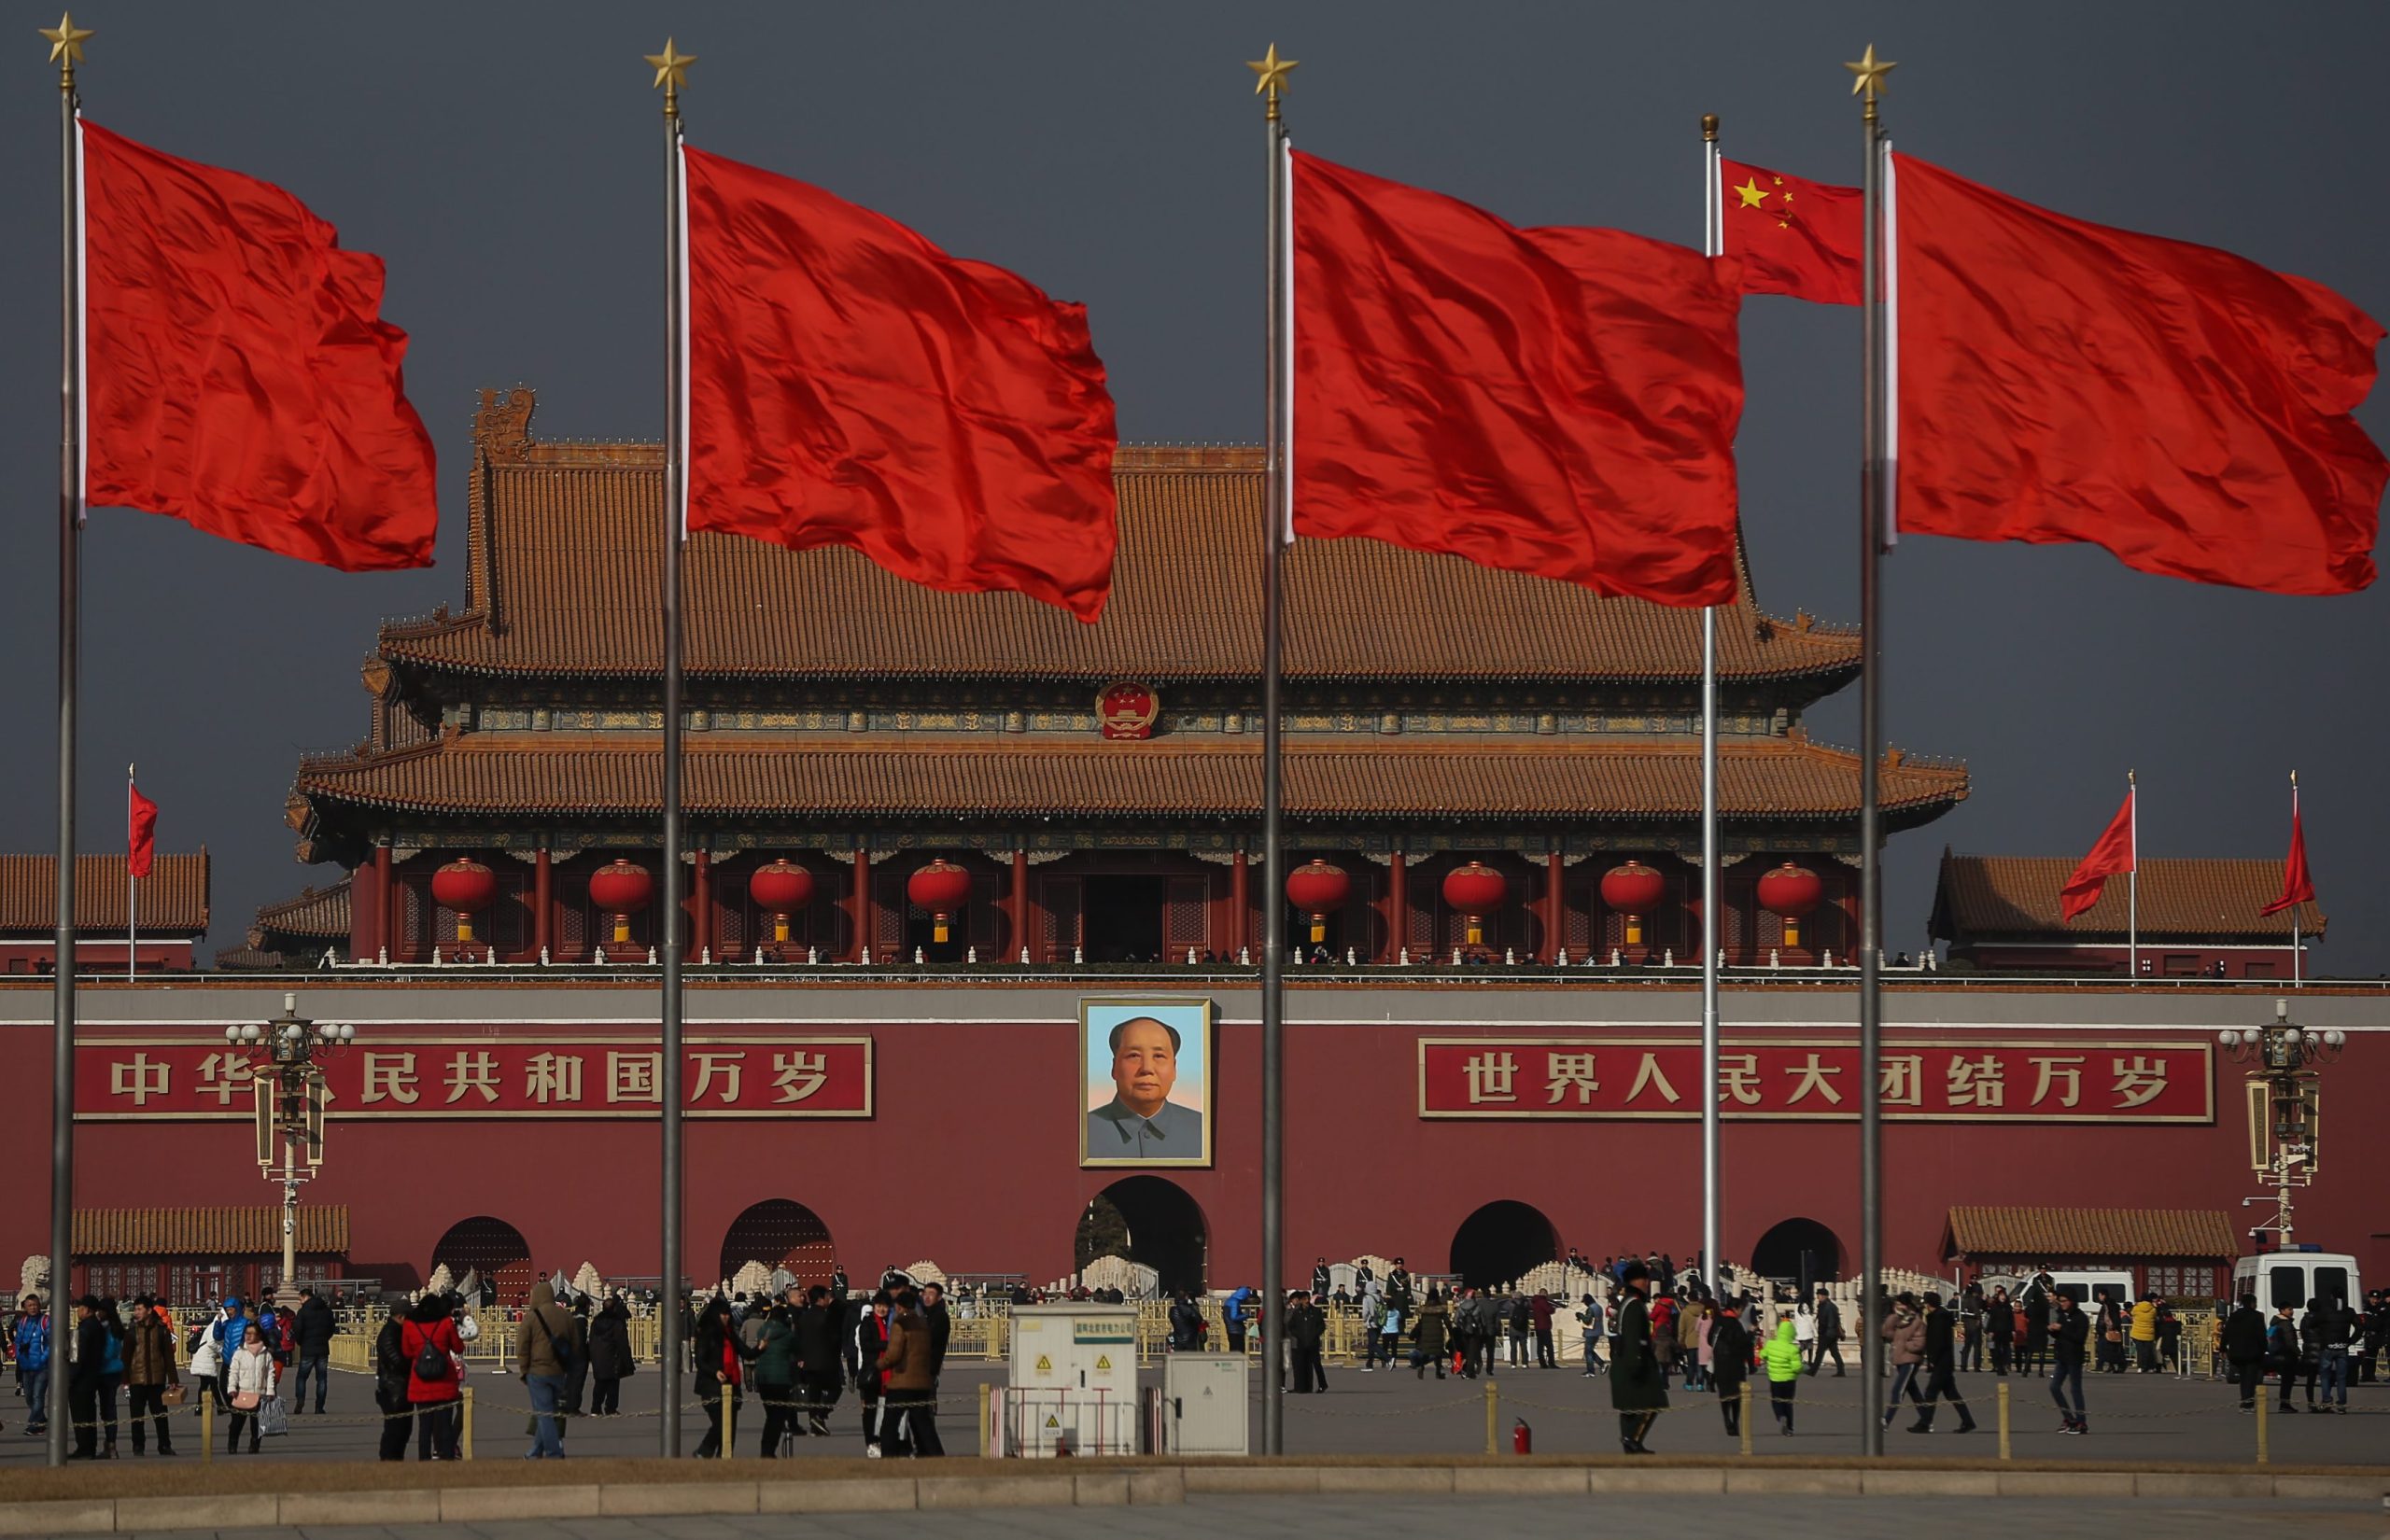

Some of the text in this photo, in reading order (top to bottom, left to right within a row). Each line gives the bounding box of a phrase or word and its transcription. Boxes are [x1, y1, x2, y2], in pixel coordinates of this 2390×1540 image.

[110, 1051, 828, 1106] 中华民共和国万岁
[1462, 1052, 2169, 1109] 世界人民大团结万岁
